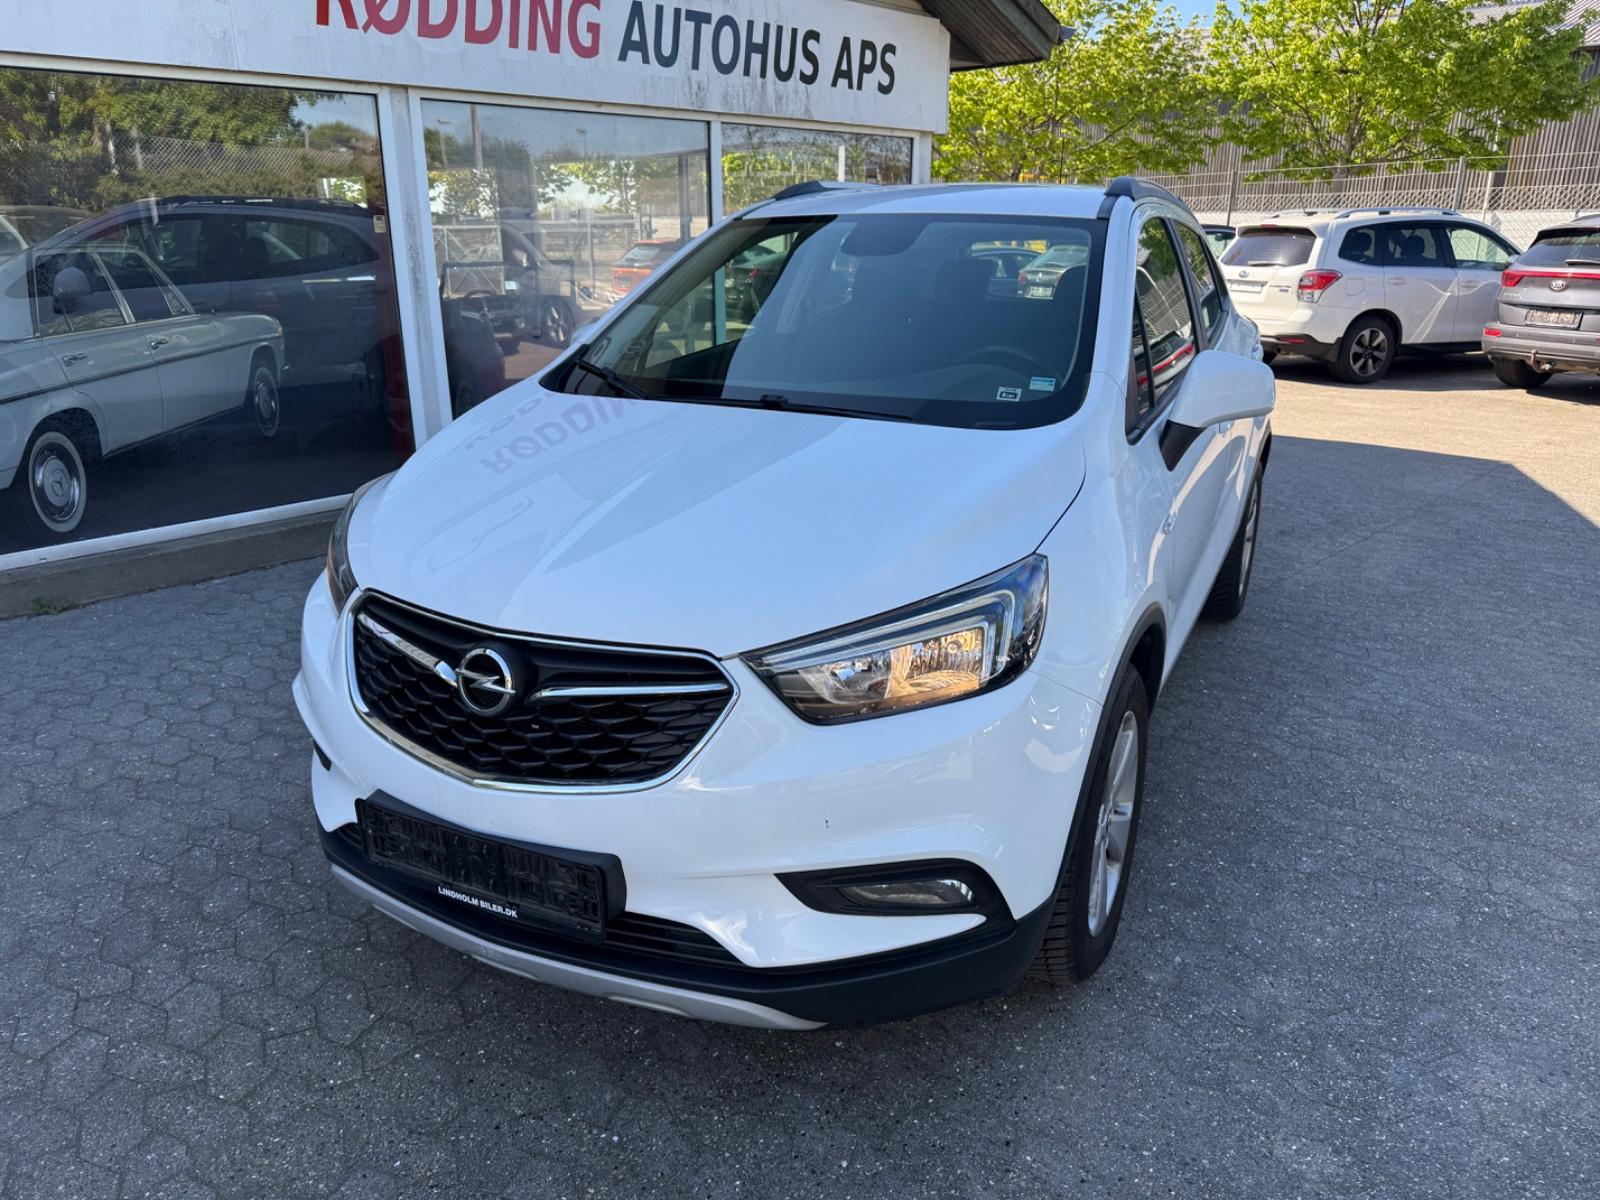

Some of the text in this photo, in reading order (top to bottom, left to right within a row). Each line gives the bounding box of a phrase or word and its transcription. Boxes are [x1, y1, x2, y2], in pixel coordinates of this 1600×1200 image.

[618, 0, 821, 85] AUTOHUS
[831, 36, 897, 95] APS
[437, 886, 518, 919] LINDHOLM BILER.DK
